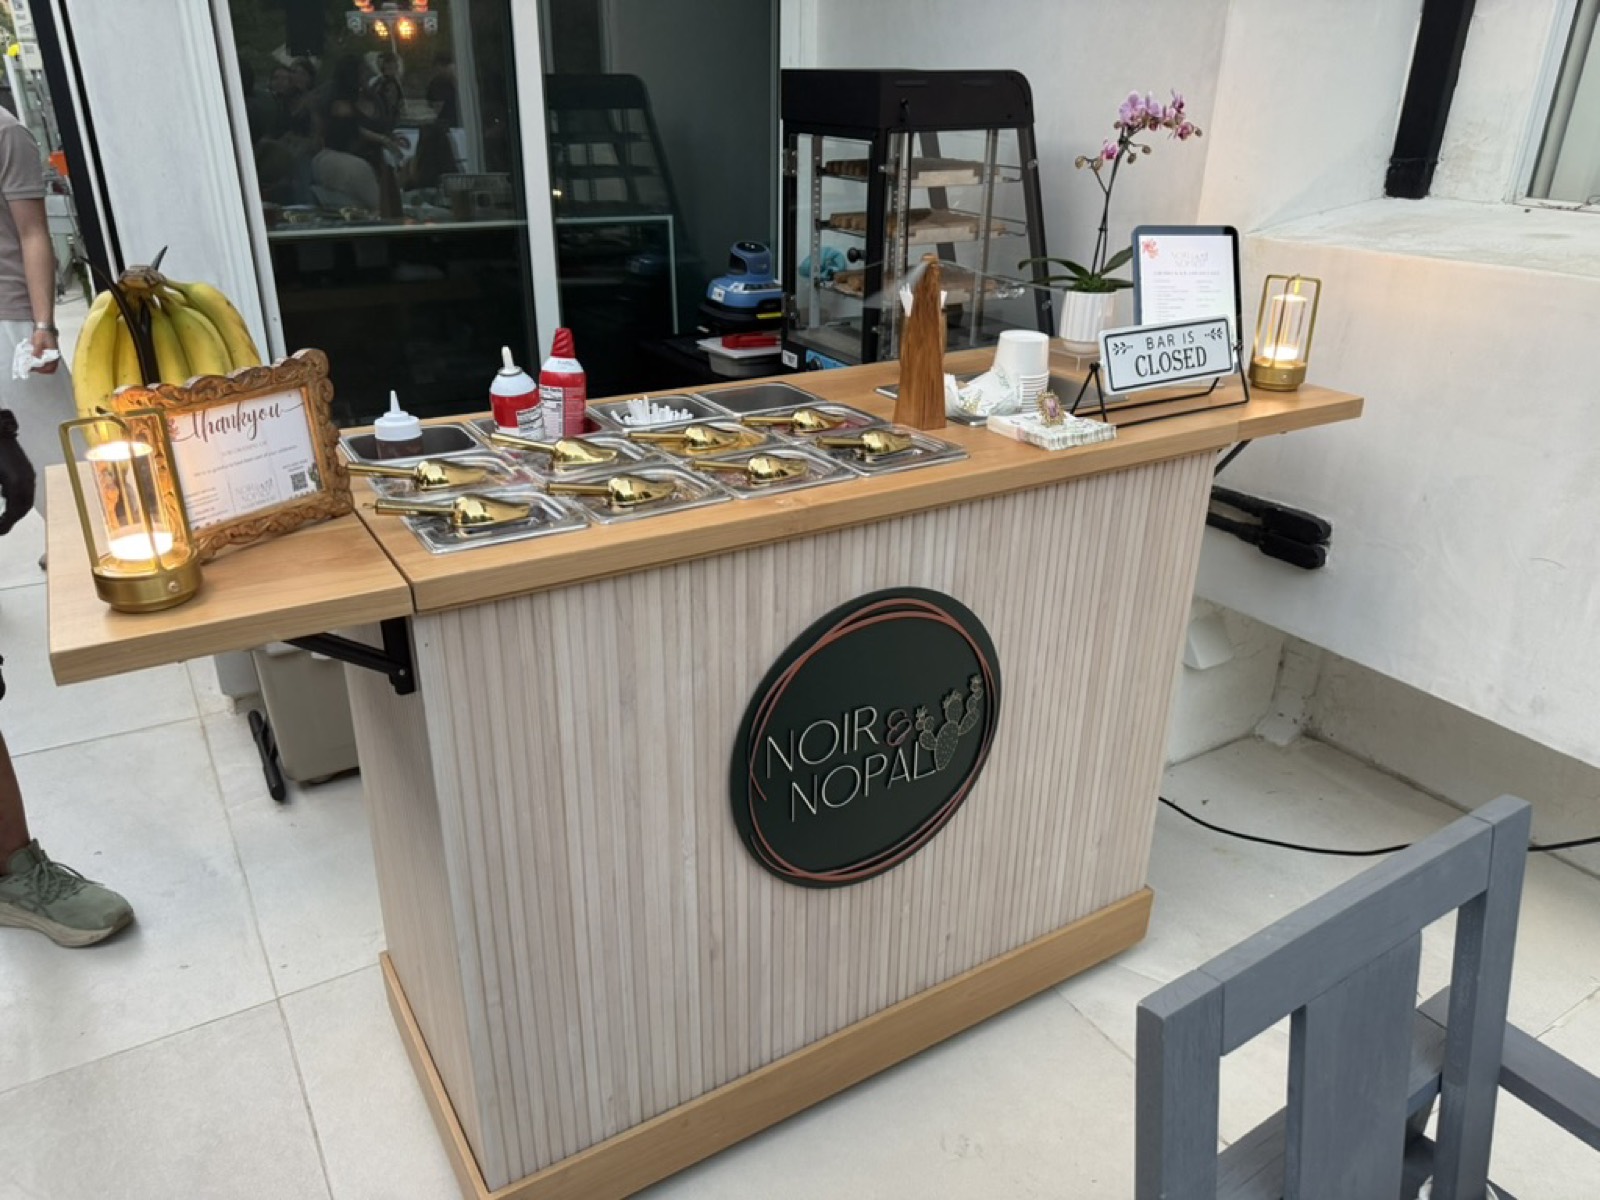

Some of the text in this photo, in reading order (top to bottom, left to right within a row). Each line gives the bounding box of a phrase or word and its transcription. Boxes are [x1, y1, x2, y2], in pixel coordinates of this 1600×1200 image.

[1135, 346, 1207, 377] CLOSED
[1145, 330, 1195, 350] BAR IS
[766, 705, 913, 779] NOIR &
[790, 741, 937, 823] NOPAL
